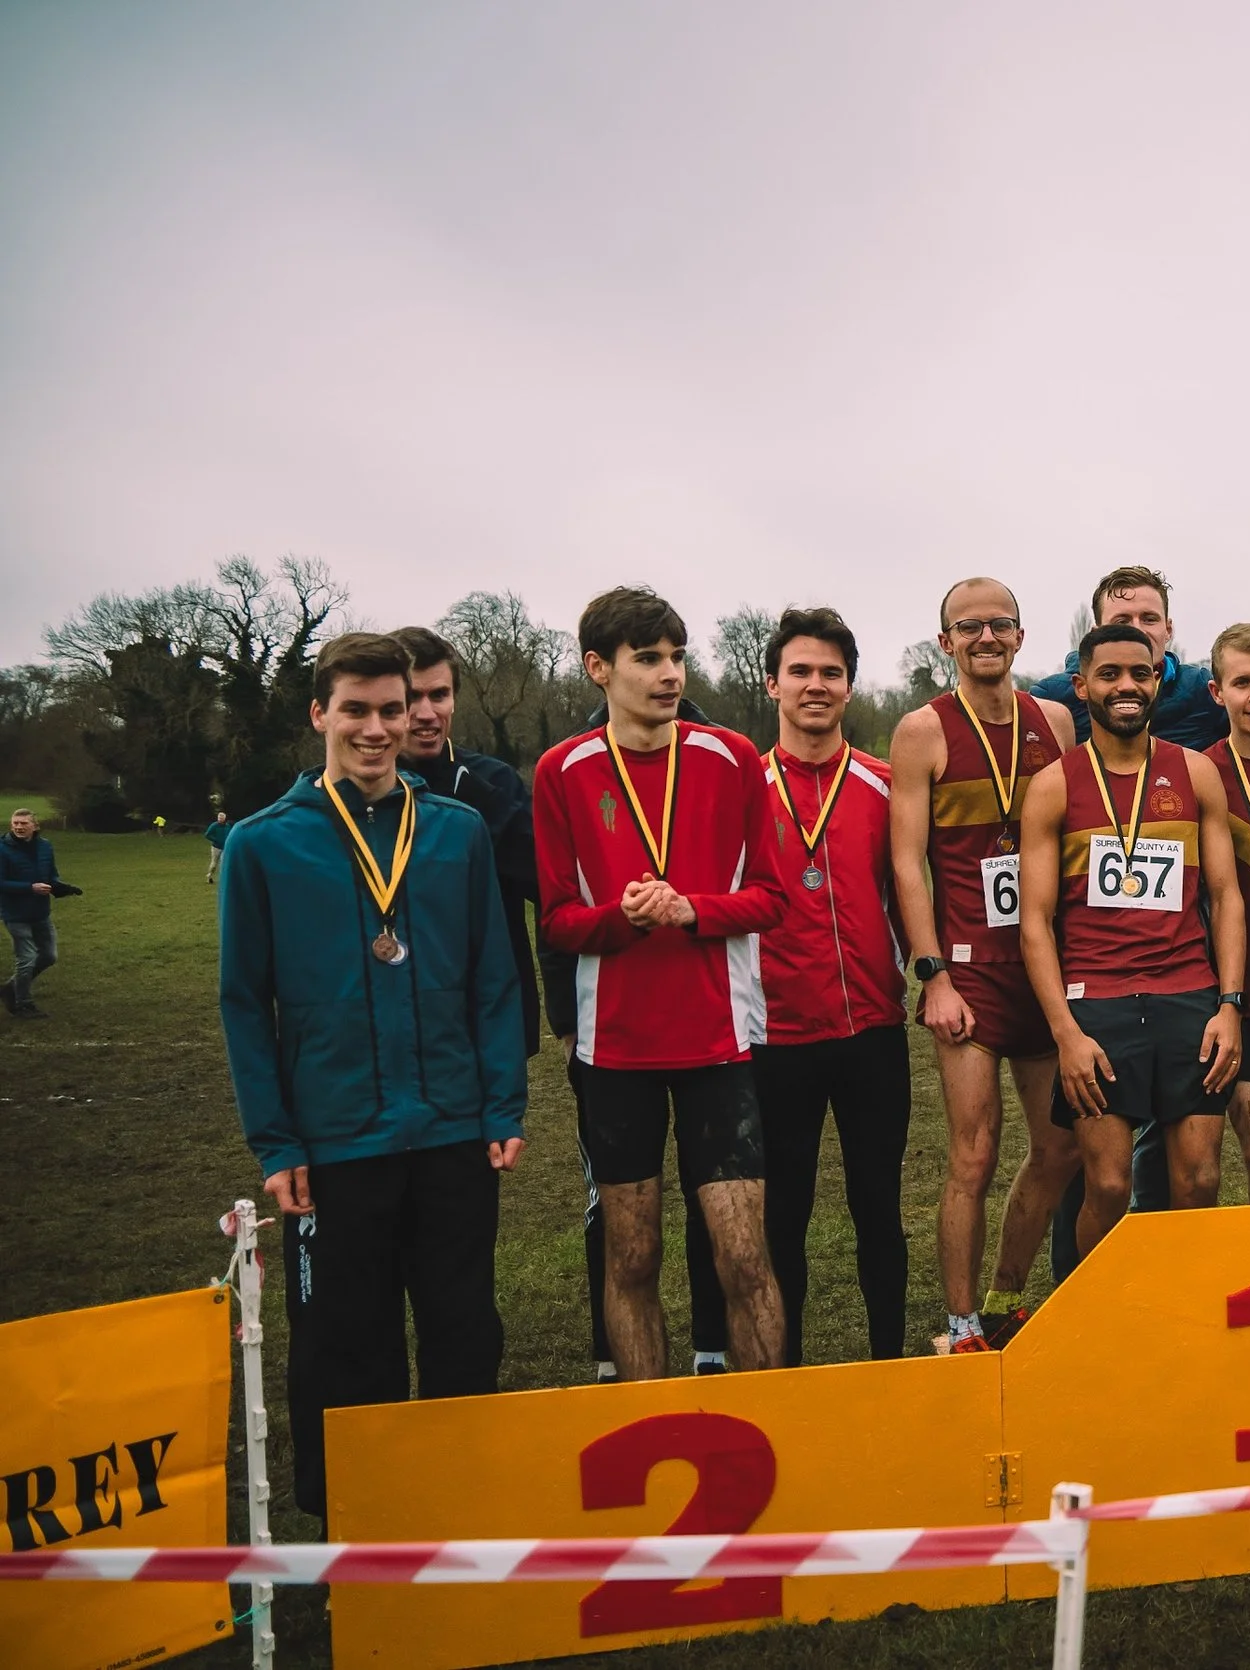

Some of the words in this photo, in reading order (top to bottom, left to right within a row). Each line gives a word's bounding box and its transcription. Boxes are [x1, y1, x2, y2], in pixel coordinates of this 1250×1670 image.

[985, 859, 1018, 869] SURREY
[1096, 839, 1123, 849] SURRE
[1136, 842, 1164, 851] OUNTY
[993, 871, 1020, 915] 6
[1098, 852, 1175, 898] 657
[0, 1432, 178, 1553] REY
[579, 1412, 783, 1638] 2
